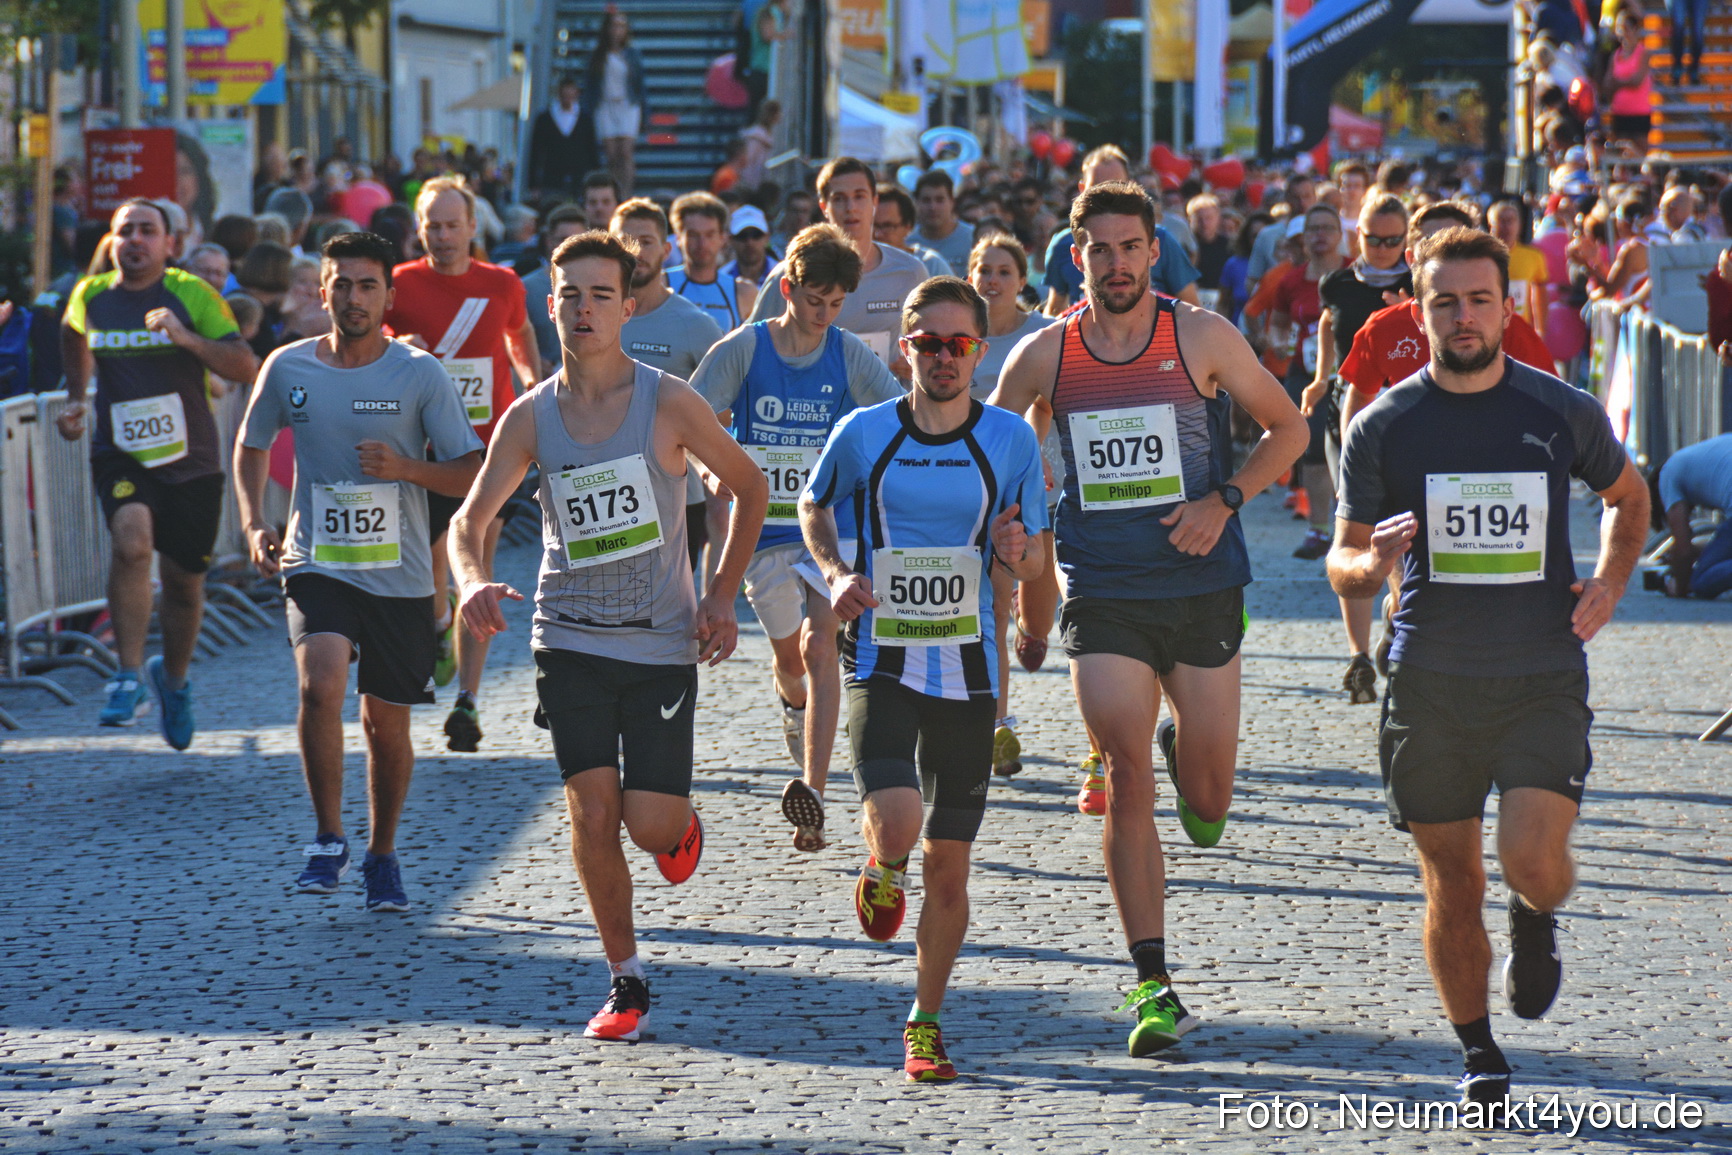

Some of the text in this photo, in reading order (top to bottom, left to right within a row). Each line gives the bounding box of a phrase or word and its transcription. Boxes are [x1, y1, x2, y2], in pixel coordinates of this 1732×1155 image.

[92, 155, 143, 181] Frei-
[867, 301, 898, 310] BOCK
[89, 330, 173, 349] BOCK
[632, 342, 670, 353] BOCK
[353, 400, 400, 411] BOCK
[787, 402, 828, 413] LEIDL &
[786, 412, 831, 422] INDERST
[1099, 417, 1145, 430] BOCK
[123, 414, 174, 441] 5203
[752, 430, 826, 447] TSG 08 Roth
[767, 452, 802, 461] BOCK
[1089, 435, 1163, 469] 5079
[573, 470, 617, 488] BOCK
[335, 491, 373, 502] BOCK
[1109, 485, 1151, 498] Philipp
[1462, 484, 1512, 494] BOCK
[566, 485, 639, 526] 5173
[325, 507, 386, 534] 5152
[1446, 504, 1529, 537] 5194
[579, 521, 629, 536] PARTL Neumarkt
[596, 536, 628, 553] Marc
[904, 557, 951, 567] BOCK
[889, 575, 965, 606] 5000
[897, 622, 957, 637] Christoph
